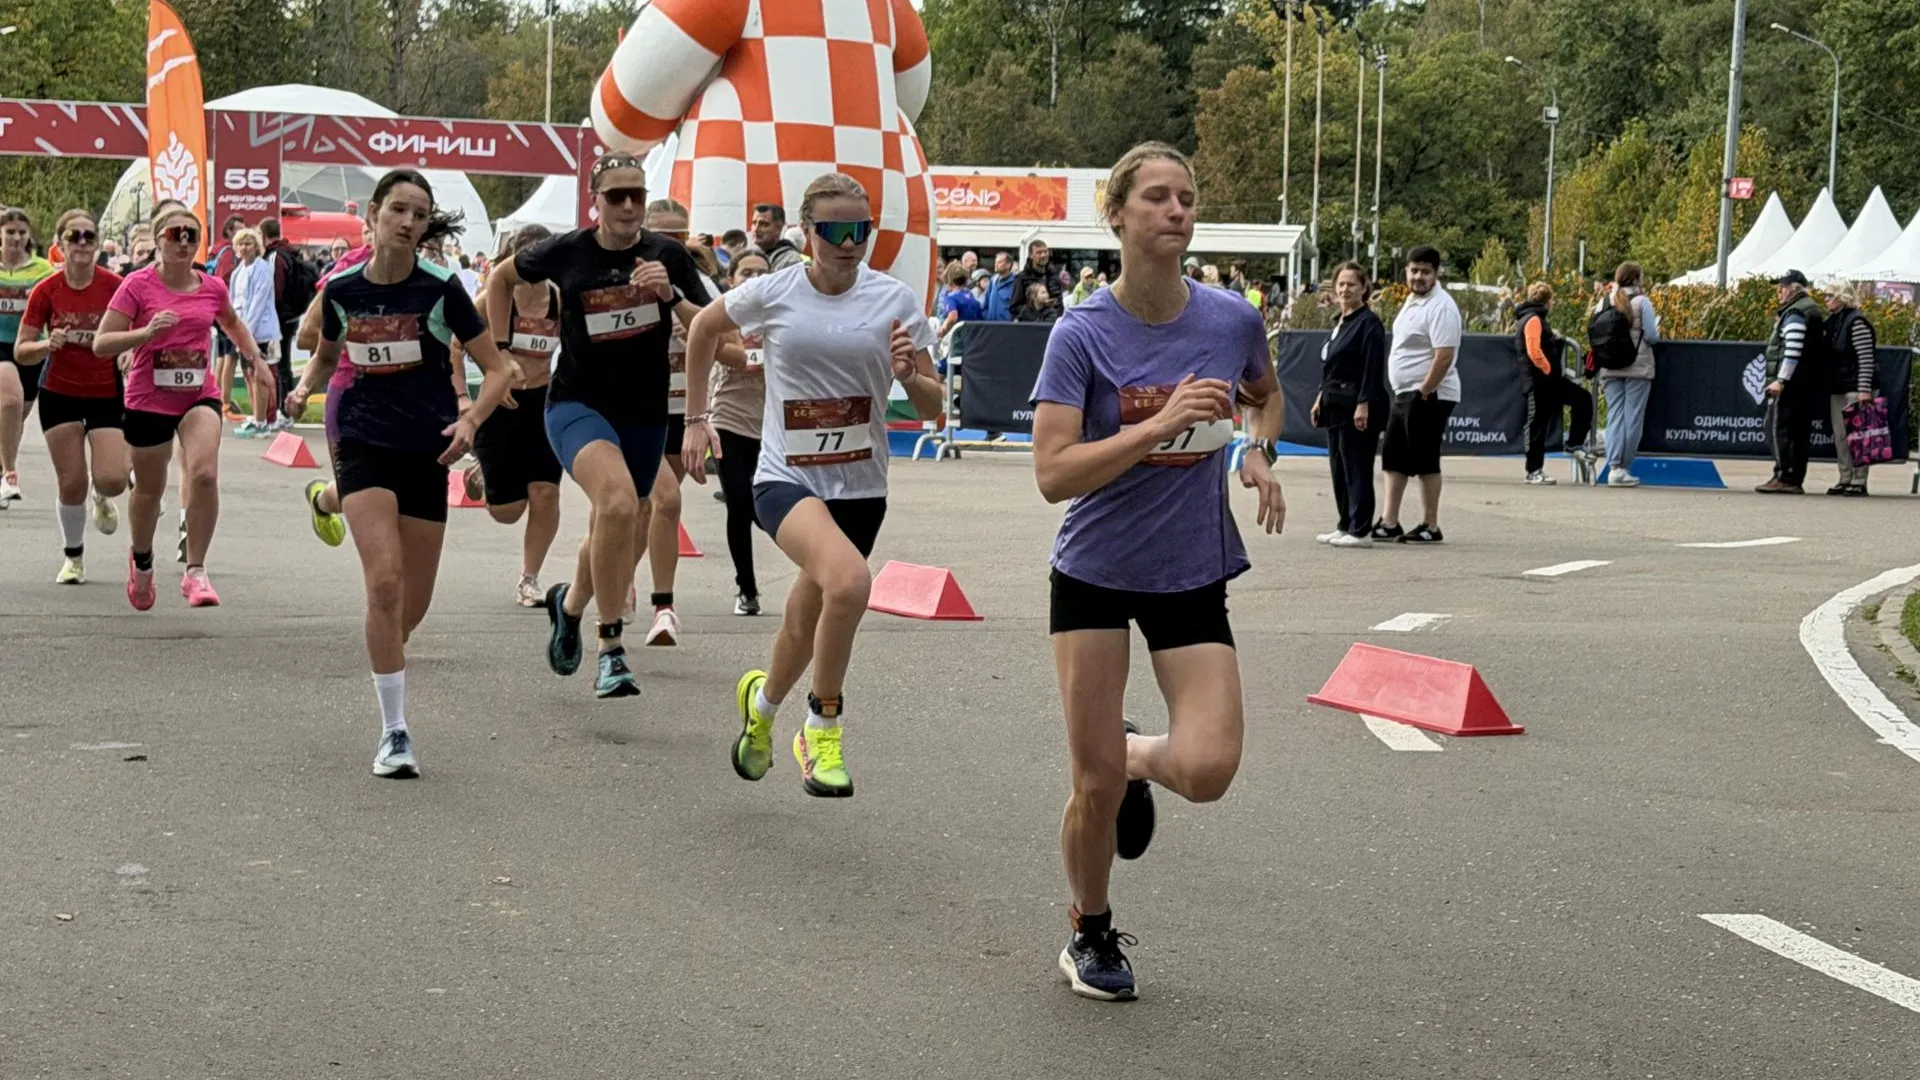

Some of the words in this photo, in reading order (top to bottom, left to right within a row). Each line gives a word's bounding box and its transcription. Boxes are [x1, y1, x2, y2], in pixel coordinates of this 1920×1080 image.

[368, 130, 497, 157] ФИНИШ
[224, 168, 270, 190] 55
[610, 311, 636, 330] 76
[530, 337, 548, 350] 80
[367, 346, 391, 363] 81
[174, 371, 194, 385] 89
[1012, 410, 1034, 420] КУЛ
[1448, 416, 1480, 428] ПАРК
[1693, 415, 1765, 429] ОДИНЦОВС
[815, 431, 845, 452] 77
[1455, 431, 1507, 443] ОТДЫХА
[1665, 429, 1730, 442] КУЛЬТУРЫ
[1738, 431, 1767, 442] СПО
